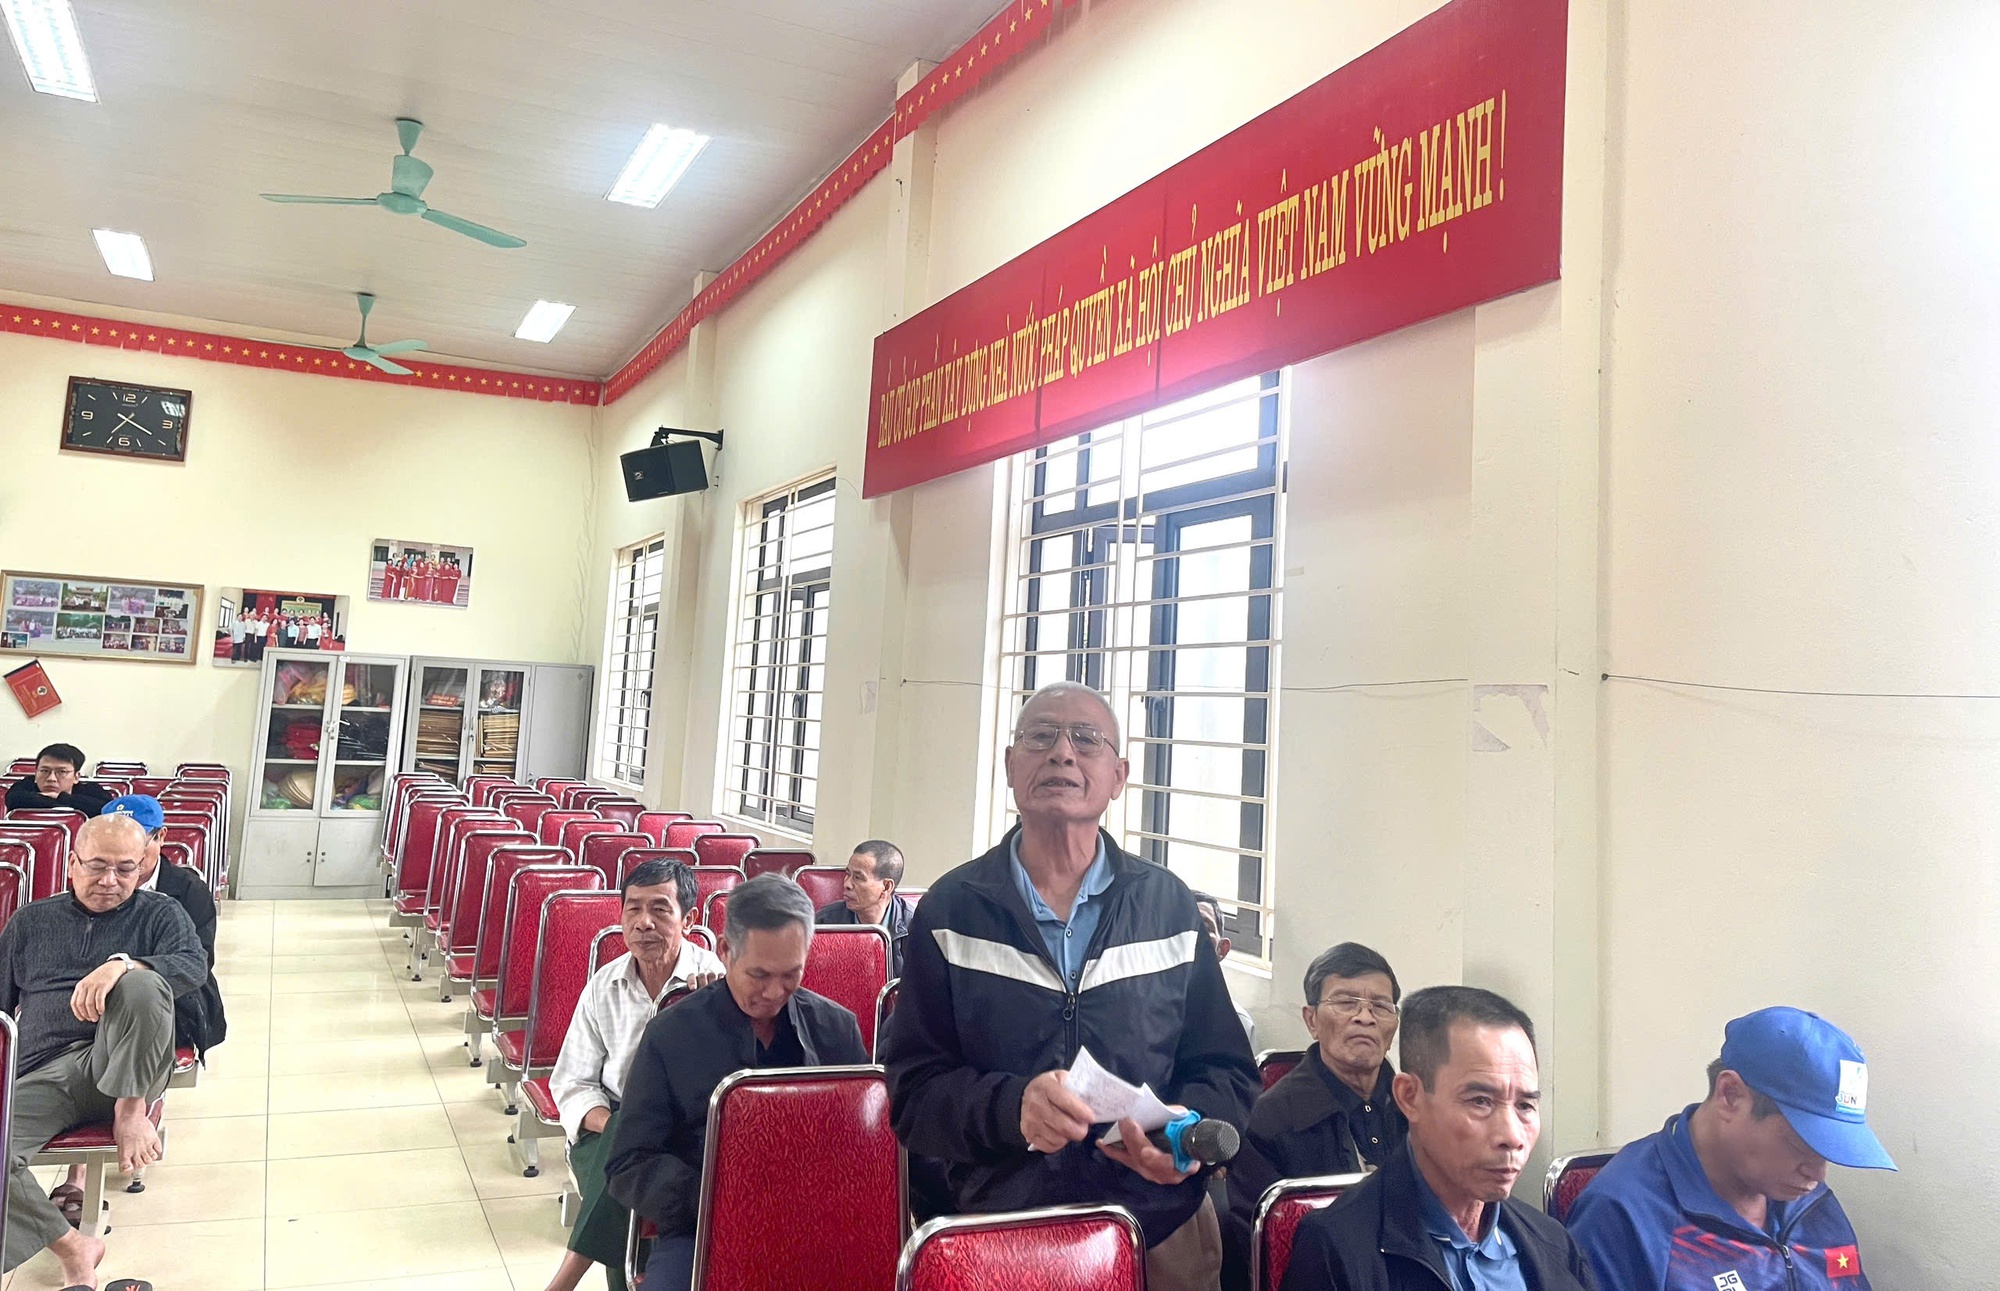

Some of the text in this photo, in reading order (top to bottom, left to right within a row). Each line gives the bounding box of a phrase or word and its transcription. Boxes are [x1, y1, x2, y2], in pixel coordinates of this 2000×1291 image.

[904, 359, 921, 438] GÓP
[920, 333, 945, 431] PHẦN
[942, 338, 964, 423] XÂY
[961, 339, 989, 431] DỰNG
[987, 314, 1010, 405] NHÀ
[1009, 301, 1040, 398] NƯỚC
[1038, 285, 1070, 386] PHÁP
[1070, 245, 1115, 378] QUYỀN
[1114, 255, 1136, 357] XÃ
[1136, 236, 1165, 367] HỘI
[1166, 203, 1198, 337] CHỦ
[1198, 200, 1251, 323] NGHĨA
[1258, 168, 1300, 317] VIỆT
[1301, 170, 1350, 280] NAM
[1354, 125, 1413, 257] VỮNG
[122, 393, 137, 403] 12
[81, 411, 94, 420] 9
[162, 420, 173, 429] 3
[118, 438, 130, 447] 6
